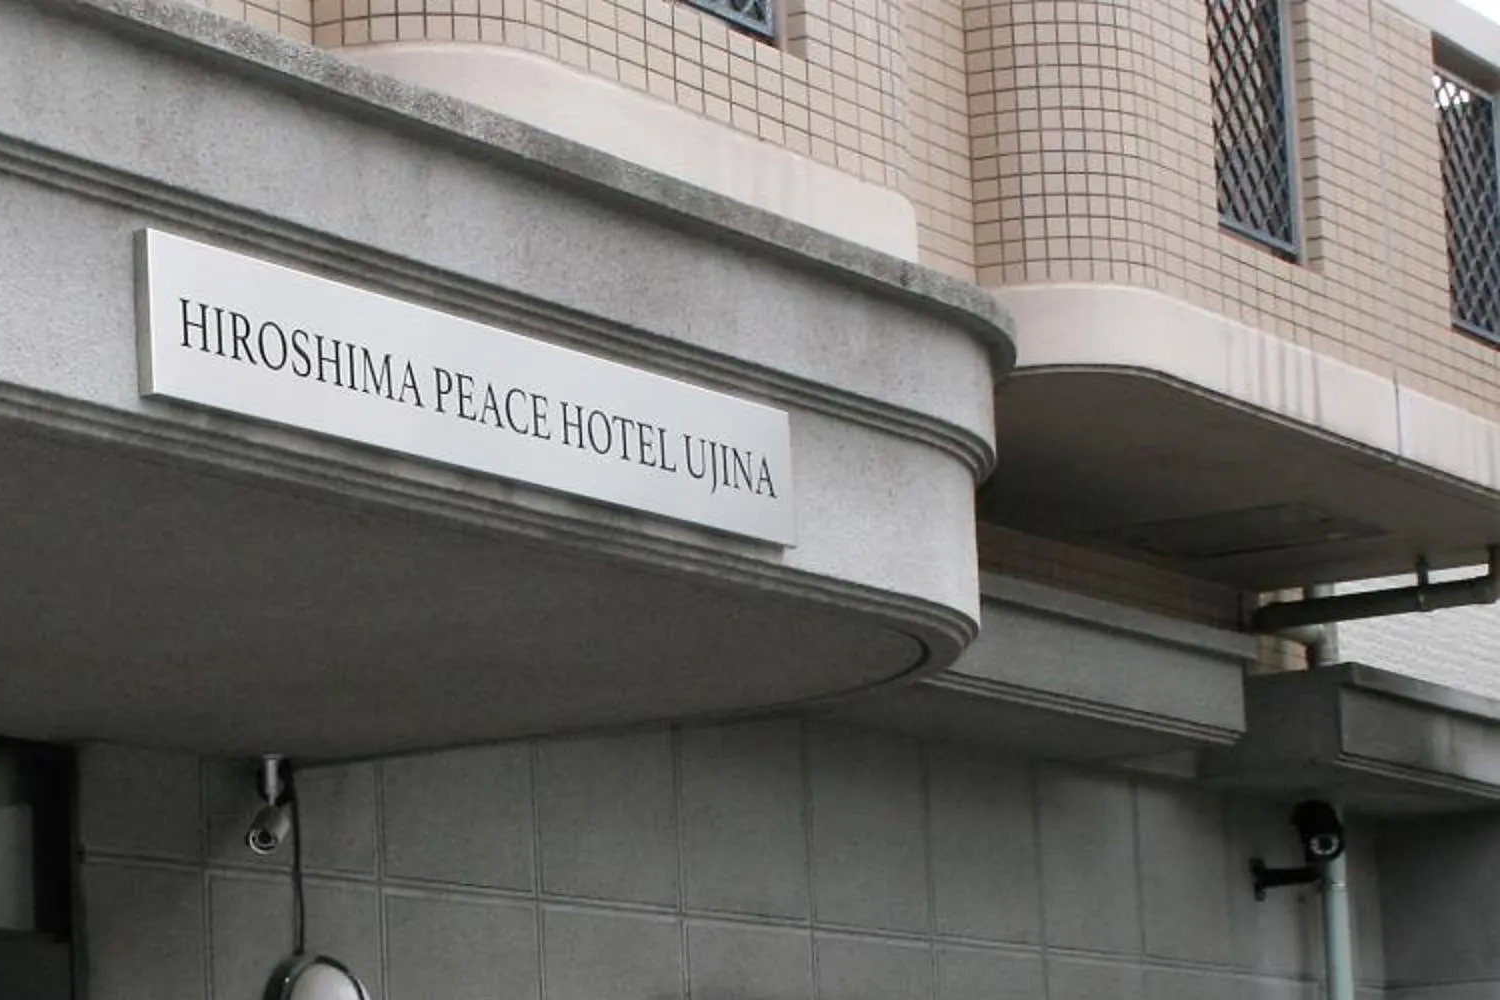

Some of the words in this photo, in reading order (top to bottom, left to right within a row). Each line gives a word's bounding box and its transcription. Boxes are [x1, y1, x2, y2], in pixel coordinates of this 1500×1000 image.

[178, 297, 425, 409] HIROSHIMA
[432, 365, 553, 441] PEACE
[559, 400, 678, 474] HOTEL
[682, 433, 779, 499] UJINA
